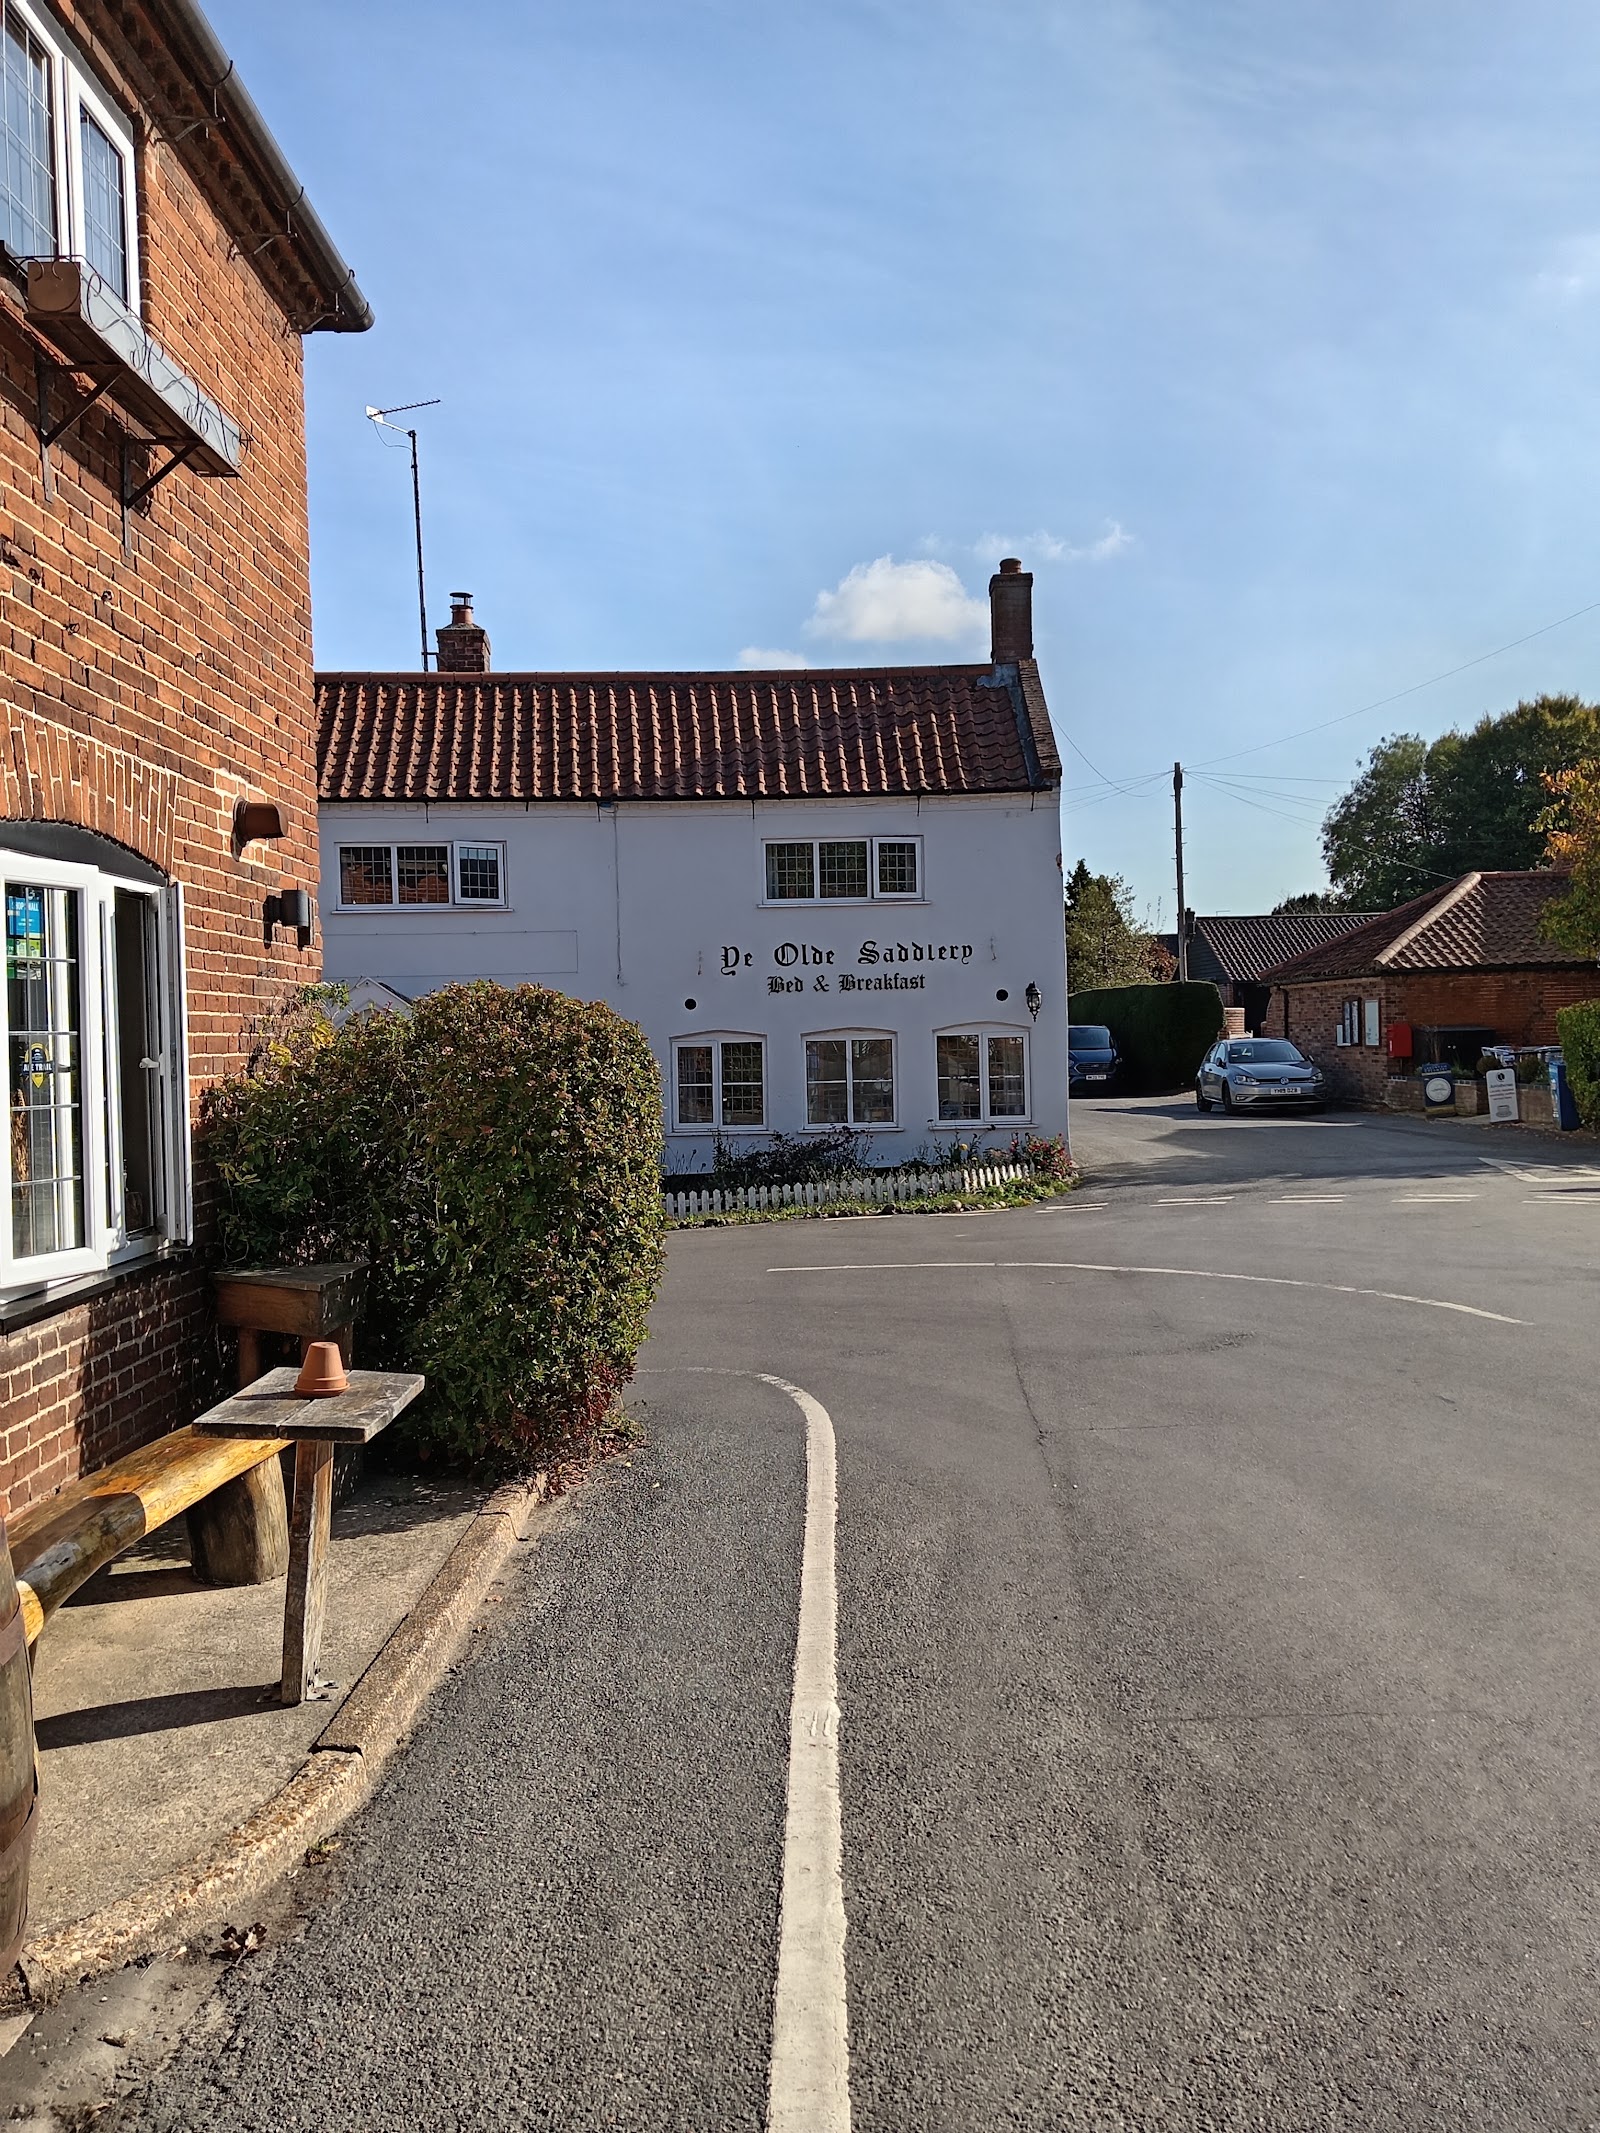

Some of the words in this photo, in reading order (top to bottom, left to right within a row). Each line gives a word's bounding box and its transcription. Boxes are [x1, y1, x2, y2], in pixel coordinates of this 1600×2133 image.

[774, 942, 835, 967] Olde
[857, 939, 974, 966] Saddlery
[767, 975, 804, 996] Bed
[812, 974, 831, 994] &
[838, 972, 926, 993] Breakfast
